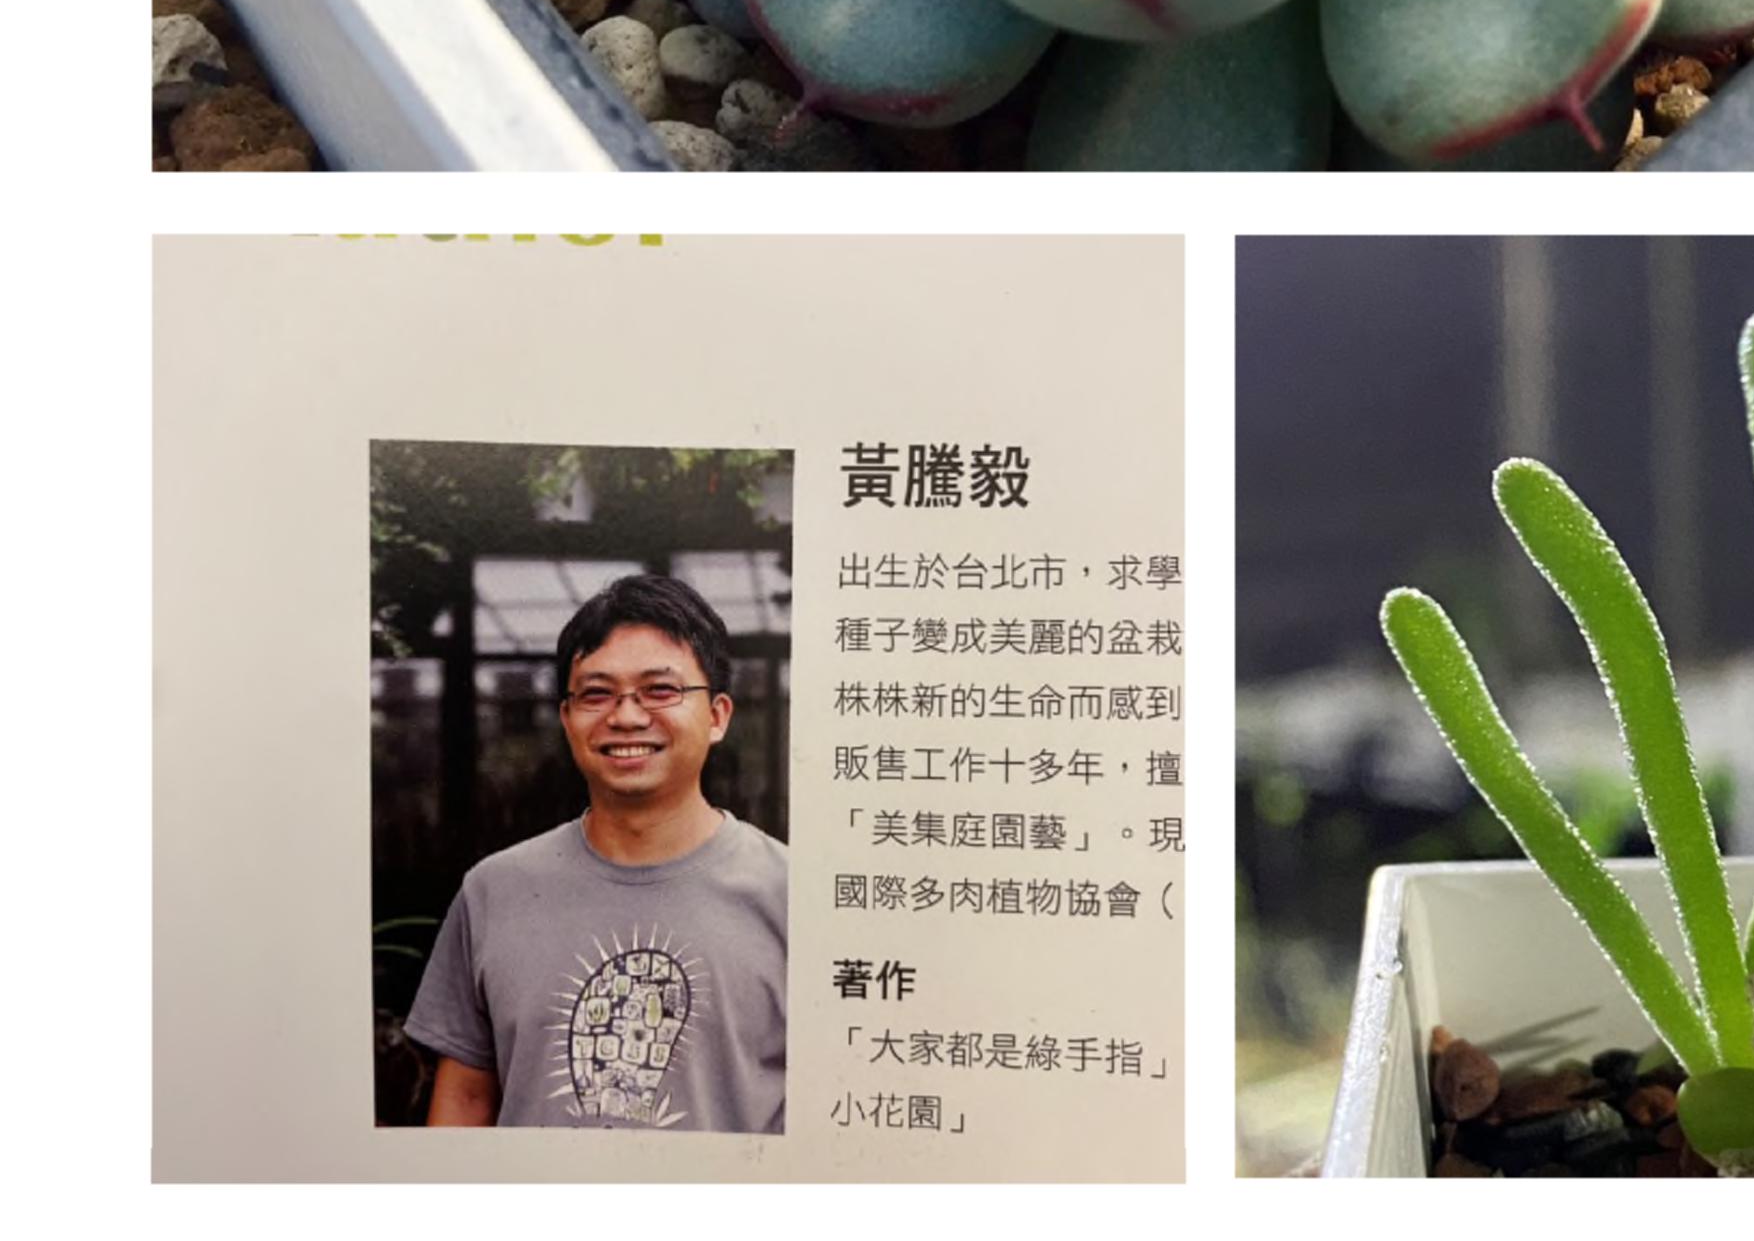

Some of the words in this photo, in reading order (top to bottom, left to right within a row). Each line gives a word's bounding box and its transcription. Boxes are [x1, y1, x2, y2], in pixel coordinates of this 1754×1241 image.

[841, 441, 1030, 508] 黃騰毅
[839, 552, 1182, 591] 出生於台北市，求學
[835, 617, 1182, 656] 種子變成美麗的盆栽
[834, 681, 1181, 721] 株株新的生命而感到
[834, 744, 1184, 786] 販售工作十多年，擅
[833, 959, 916, 1001] 著作
[848, 1027, 1166, 1079] 「大家都是綠手指」
[831, 1092, 964, 1133] 小花園」
